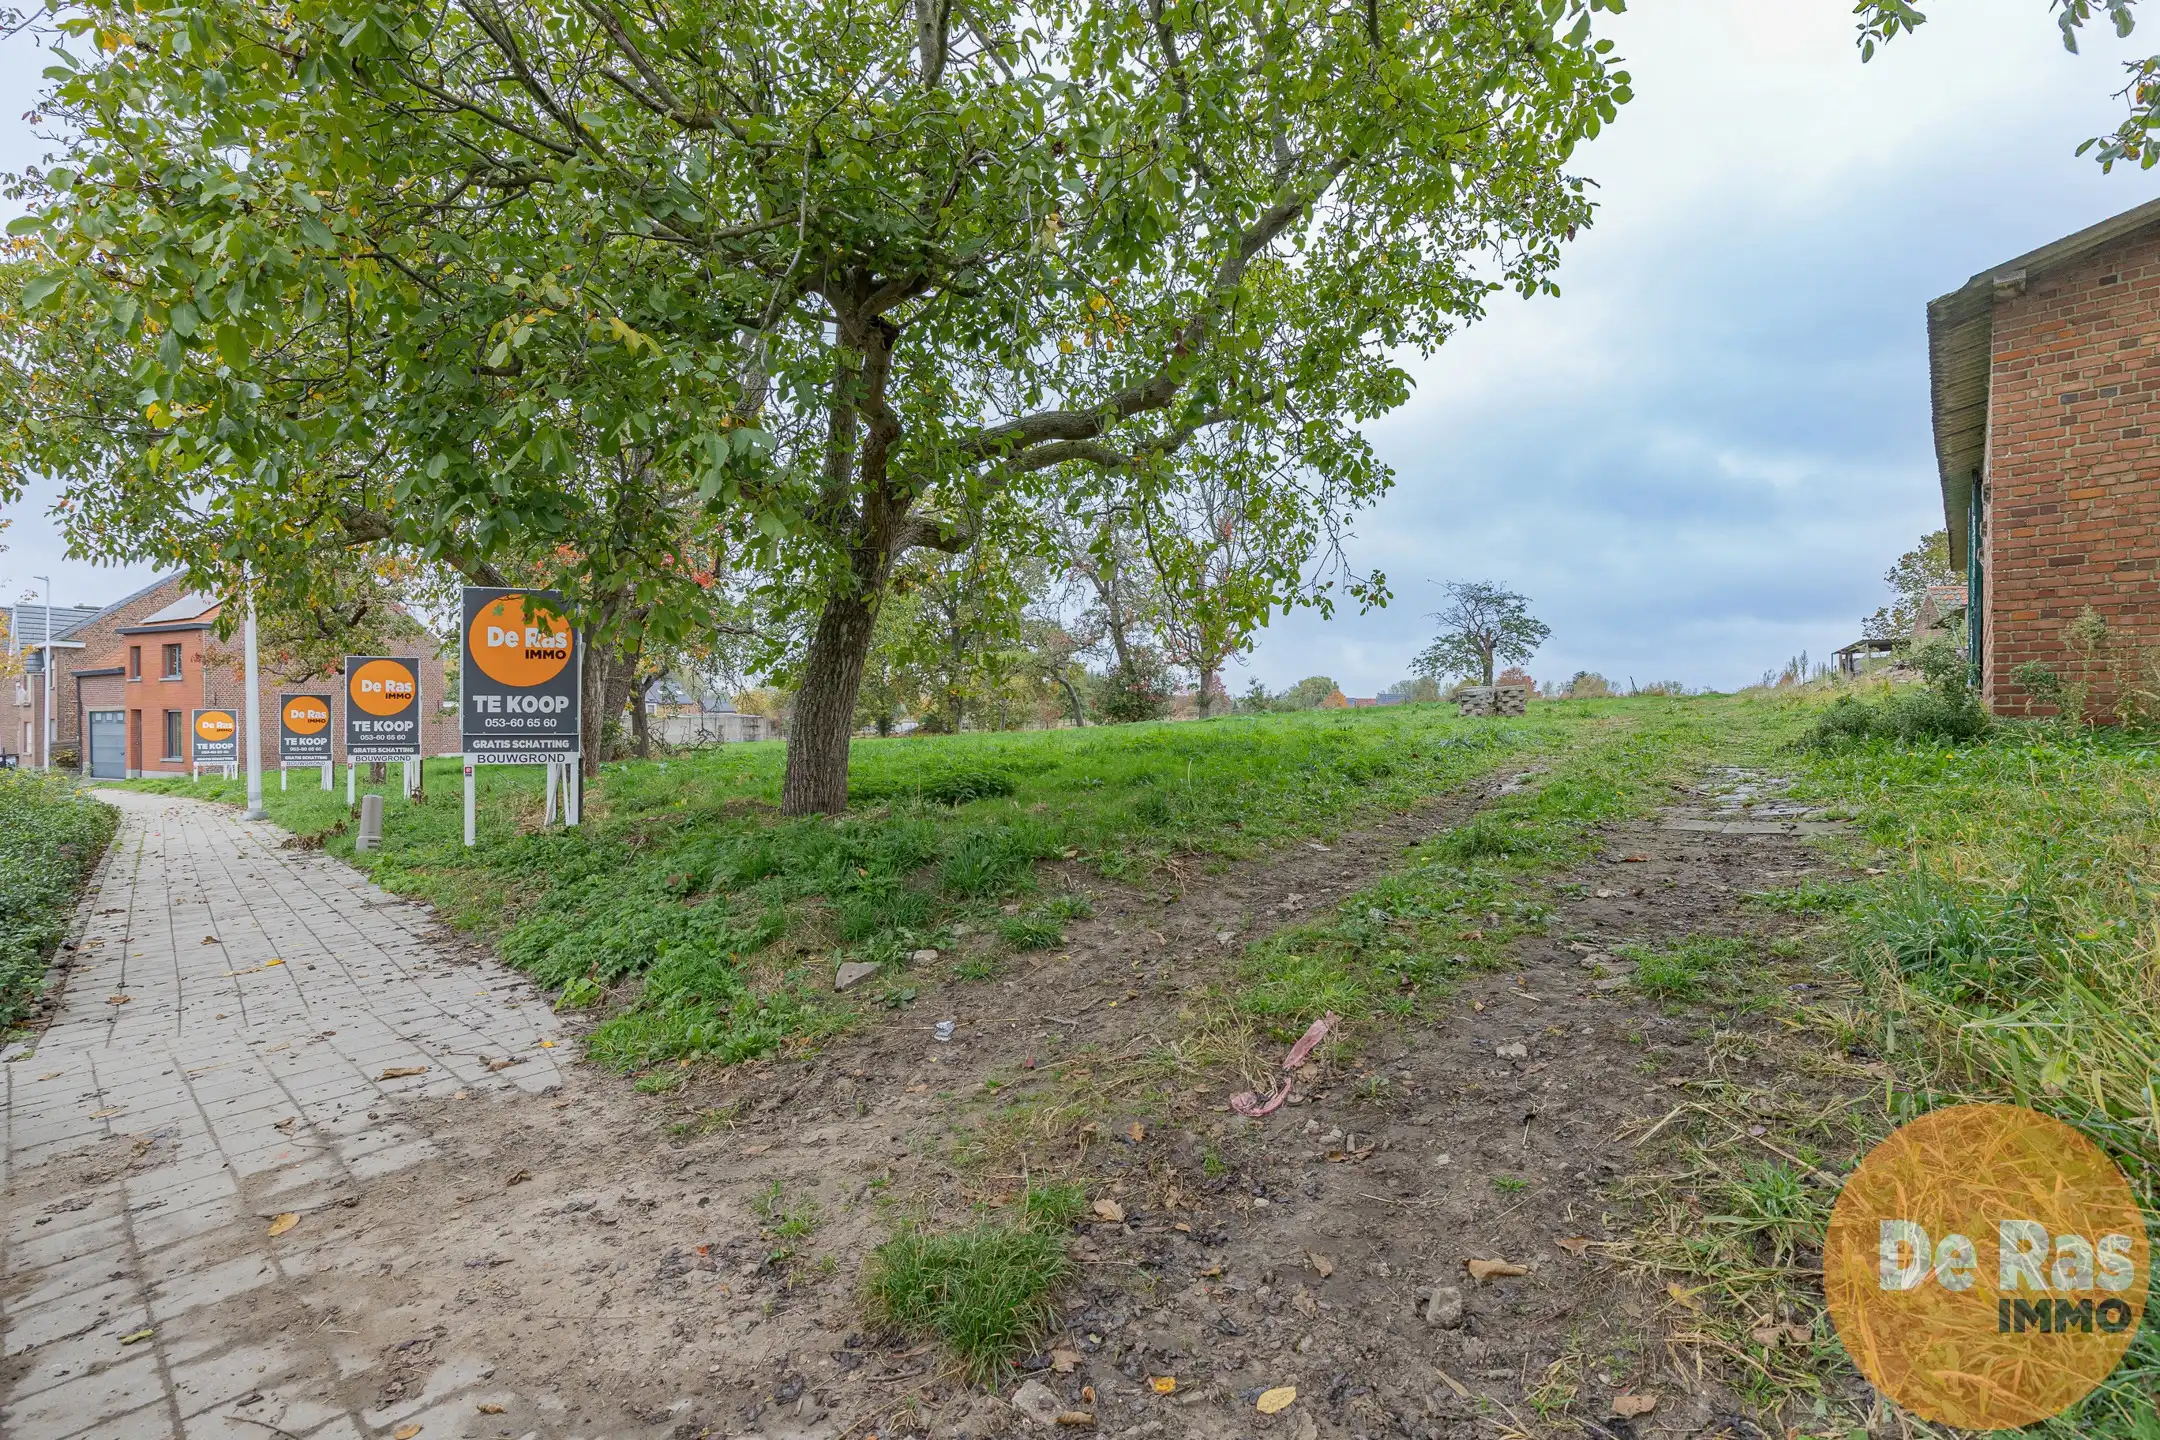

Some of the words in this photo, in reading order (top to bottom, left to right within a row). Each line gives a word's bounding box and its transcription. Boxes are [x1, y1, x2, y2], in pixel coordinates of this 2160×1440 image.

[487, 626, 519, 648] De
[525, 627, 568, 648] Ras
[525, 650, 566, 659] IMMO
[361, 679, 382, 693] De
[385, 679, 412, 693] Ras
[472, 695, 501, 713] TE
[506, 695, 569, 713] KOOP
[290, 709, 305, 719] De
[307, 709, 327, 719] Ras
[352, 721, 371, 732] TE
[373, 721, 414, 732] KOOP
[485, 718, 524, 727] 053-60
[526, 718, 541, 727] 65
[543, 718, 557, 727] 60
[284, 737, 298, 746] TE
[299, 737, 328, 746] KOOP
[472, 740, 510, 749] GRATIS
[512, 740, 570, 749] SCHATTING
[477, 754, 566, 763] BOUWGROND
